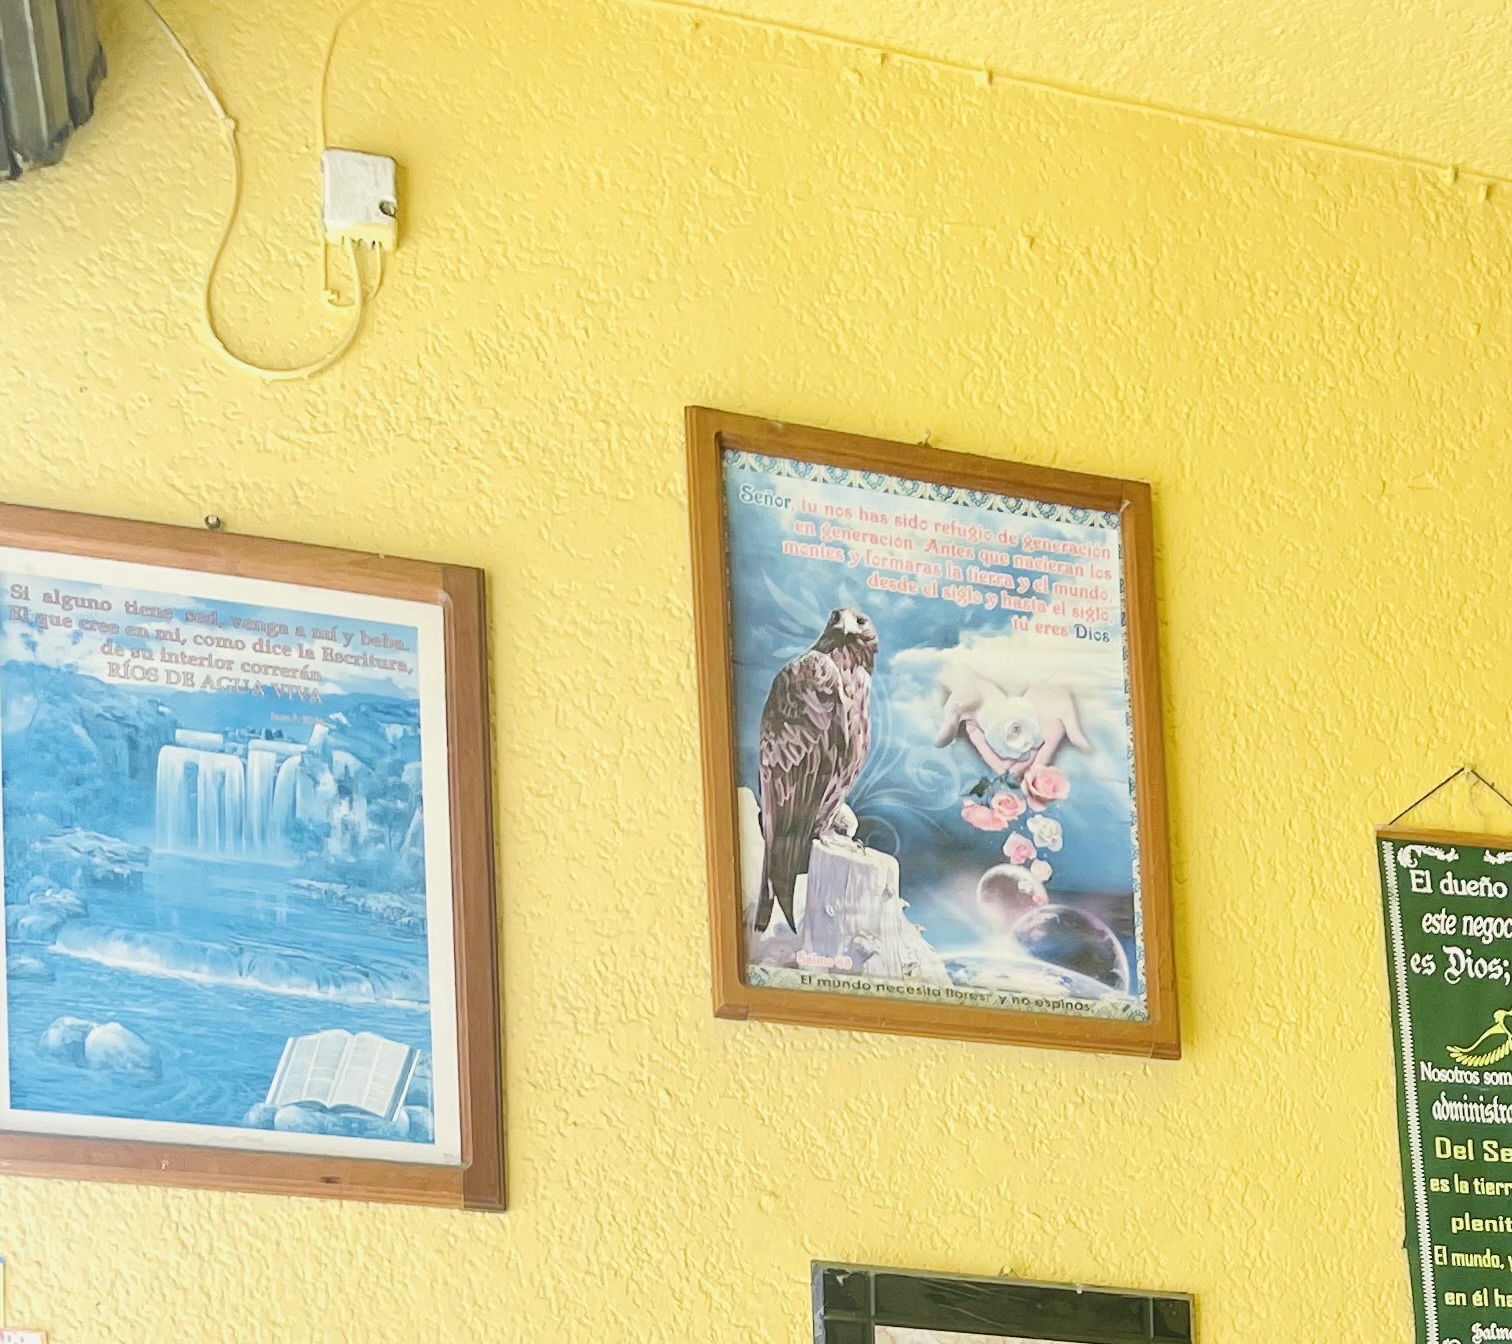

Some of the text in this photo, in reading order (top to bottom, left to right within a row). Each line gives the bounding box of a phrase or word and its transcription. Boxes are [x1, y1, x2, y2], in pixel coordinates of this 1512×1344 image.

[740, 485, 1111, 559] Señor, nos has sido refugio de generación
[784, 541, 843, 560] montes
[849, 551, 860, 566] y
[946, 561, 962, 580] la
[968, 566, 1014, 588] tierra
[1018, 577, 1030, 592] y
[1033, 575, 1048, 593] el
[795, 521, 1112, 580] en Antes que nacieran los
[867, 571, 918, 596] desde
[919, 578, 938, 599] el
[942, 585, 982, 605] siglo
[986, 593, 998, 609] y
[1002, 591, 1047, 613] hasta
[1053, 602, 1065, 615] el
[10, 584, 30, 600] Si
[43, 589, 112, 611] alguno
[125, 601, 173, 619] tiene
[230, 616, 288, 637] venga
[295, 626, 306, 637] a
[342, 632, 354, 648] y
[1035, 622, 1068, 637] eres
[9, 605, 414, 674] El que cree en como dice la Escritura,
[101, 639, 322, 682] de su interior correrán
[108, 660, 159, 682] RÍOS
[165, 669, 195, 687] DE
[200, 675, 265, 697] AGUA
[1409, 869, 1433, 894] El
[1439, 872, 1508, 898] dueño
[1422, 908, 1457, 935] este
[1410, 945, 1511, 986] es Dios;
[801, 975, 811, 985] El
[817, 978, 871, 991] mundo
[876, 983, 941, 997] necesita
[999, 995, 1007, 1005] y
[1012, 996, 1030, 1006] no
[1420, 1061, 1480, 1085] Nosotros
[1435, 1136, 1474, 1160] Del
[1430, 1178, 1449, 1192] es
[1454, 1174, 1470, 1193] la
[1434, 1246, 1447, 1266] El
[1445, 1291, 1467, 1307] en
[1472, 1287, 1488, 1307] él
